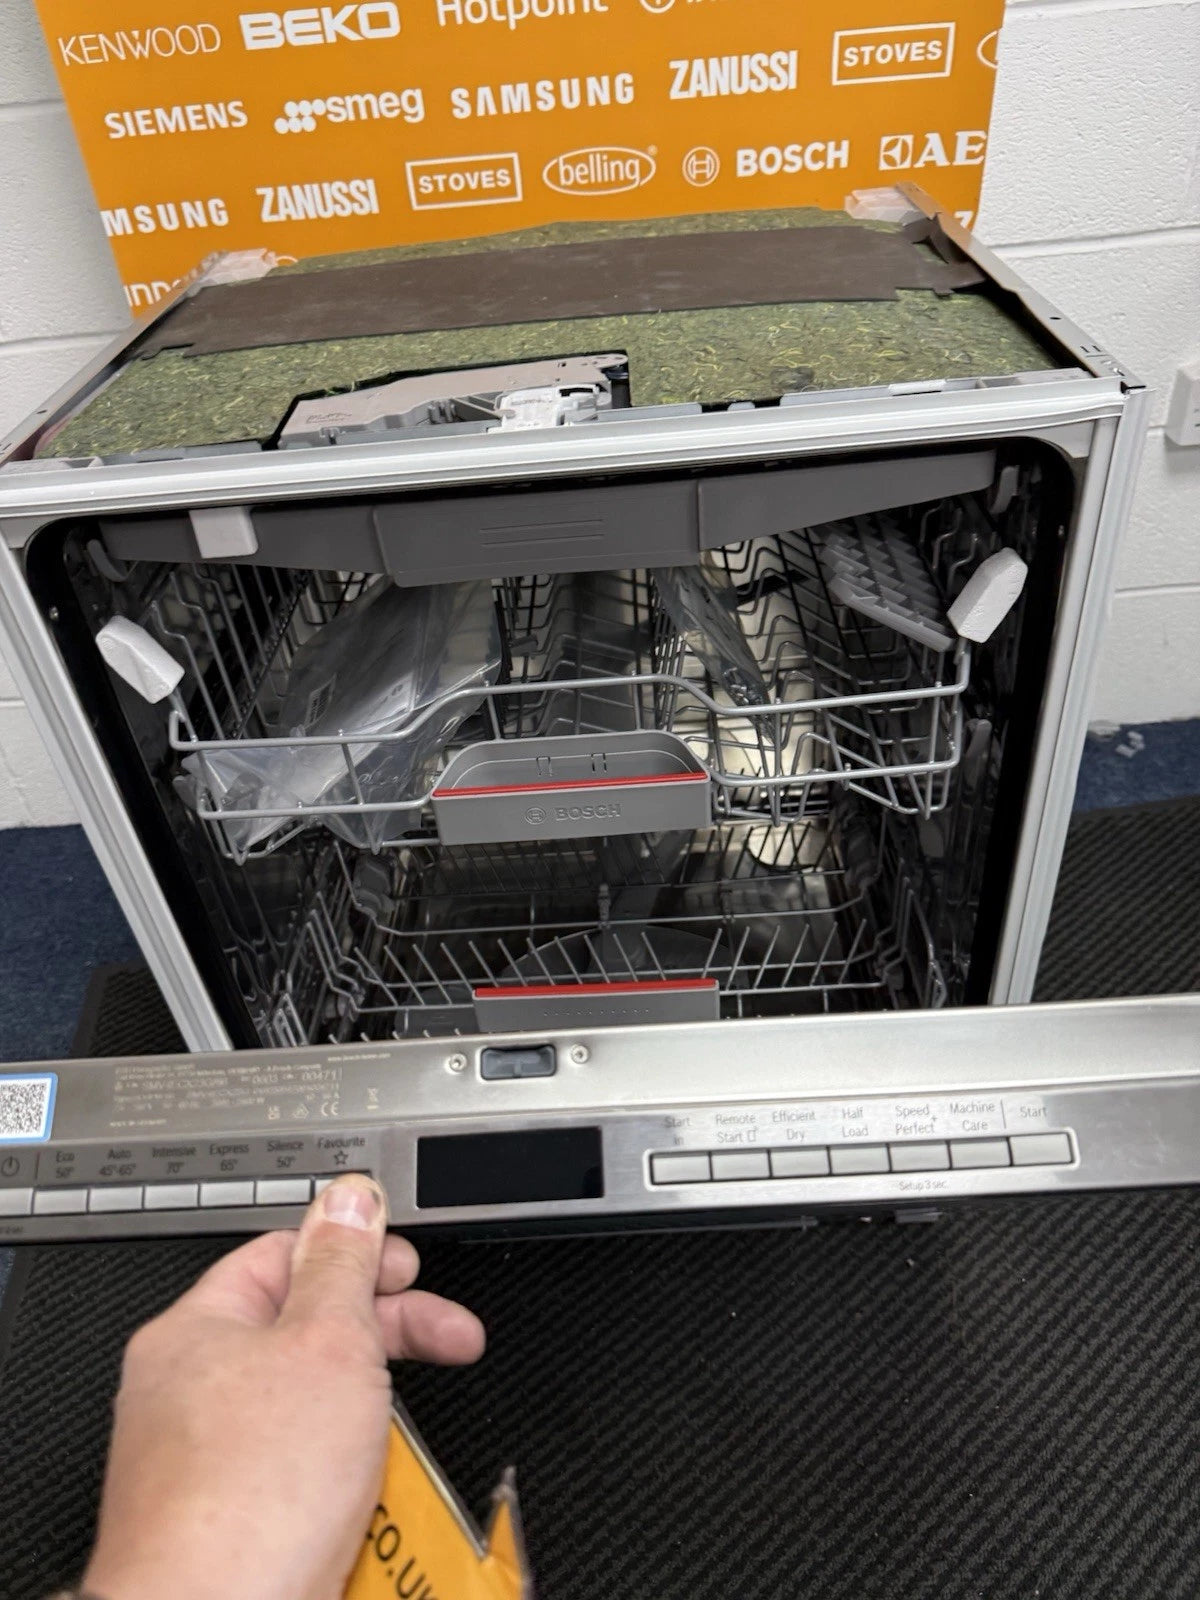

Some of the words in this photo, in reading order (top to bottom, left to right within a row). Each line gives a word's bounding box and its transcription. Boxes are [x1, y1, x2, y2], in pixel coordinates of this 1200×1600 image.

[436, 0, 609, 30] Hotpoint
[239, 1, 401, 51] BEKO
[58, 23, 221, 66] KENWOOD
[843, 40, 943, 68] STOVES
[669, 50, 798, 100] ZANUSSI
[451, 73, 635, 119] SAMSUNG
[325, 88, 425, 124] smeg
[104, 101, 249, 139] SIEMENS
[736, 140, 849, 177] BOSCH
[558, 153, 640, 187] belling
[418, 168, 512, 194] STOVES
[256, 179, 379, 222] ZANUSSI
[555, 803, 621, 821] BOSCH
[842, 1107, 864, 1119] Half
[895, 1105, 930, 1118] Speed
[949, 1101, 995, 1114] Machine
[1020, 1106, 1047, 1118] Start
[664, 1116, 691, 1128] Start
[715, 1114, 756, 1126] Remote
[772, 1111, 816, 1123] Efficient
[842, 1125, 869, 1138] Load
[962, 1119, 989, 1132] Care
[717, 1132, 744, 1144] Start
[786, 1129, 805, 1142] Dry
[267, 1140, 304, 1151] Silence
[317, 1136, 366, 1149] Favourite
[107, 1149, 131, 1160] Auto
[152, 1147, 196, 1158] Intensive
[210, 1143, 249, 1156] Express
[56, 1151, 75, 1162] Eco
